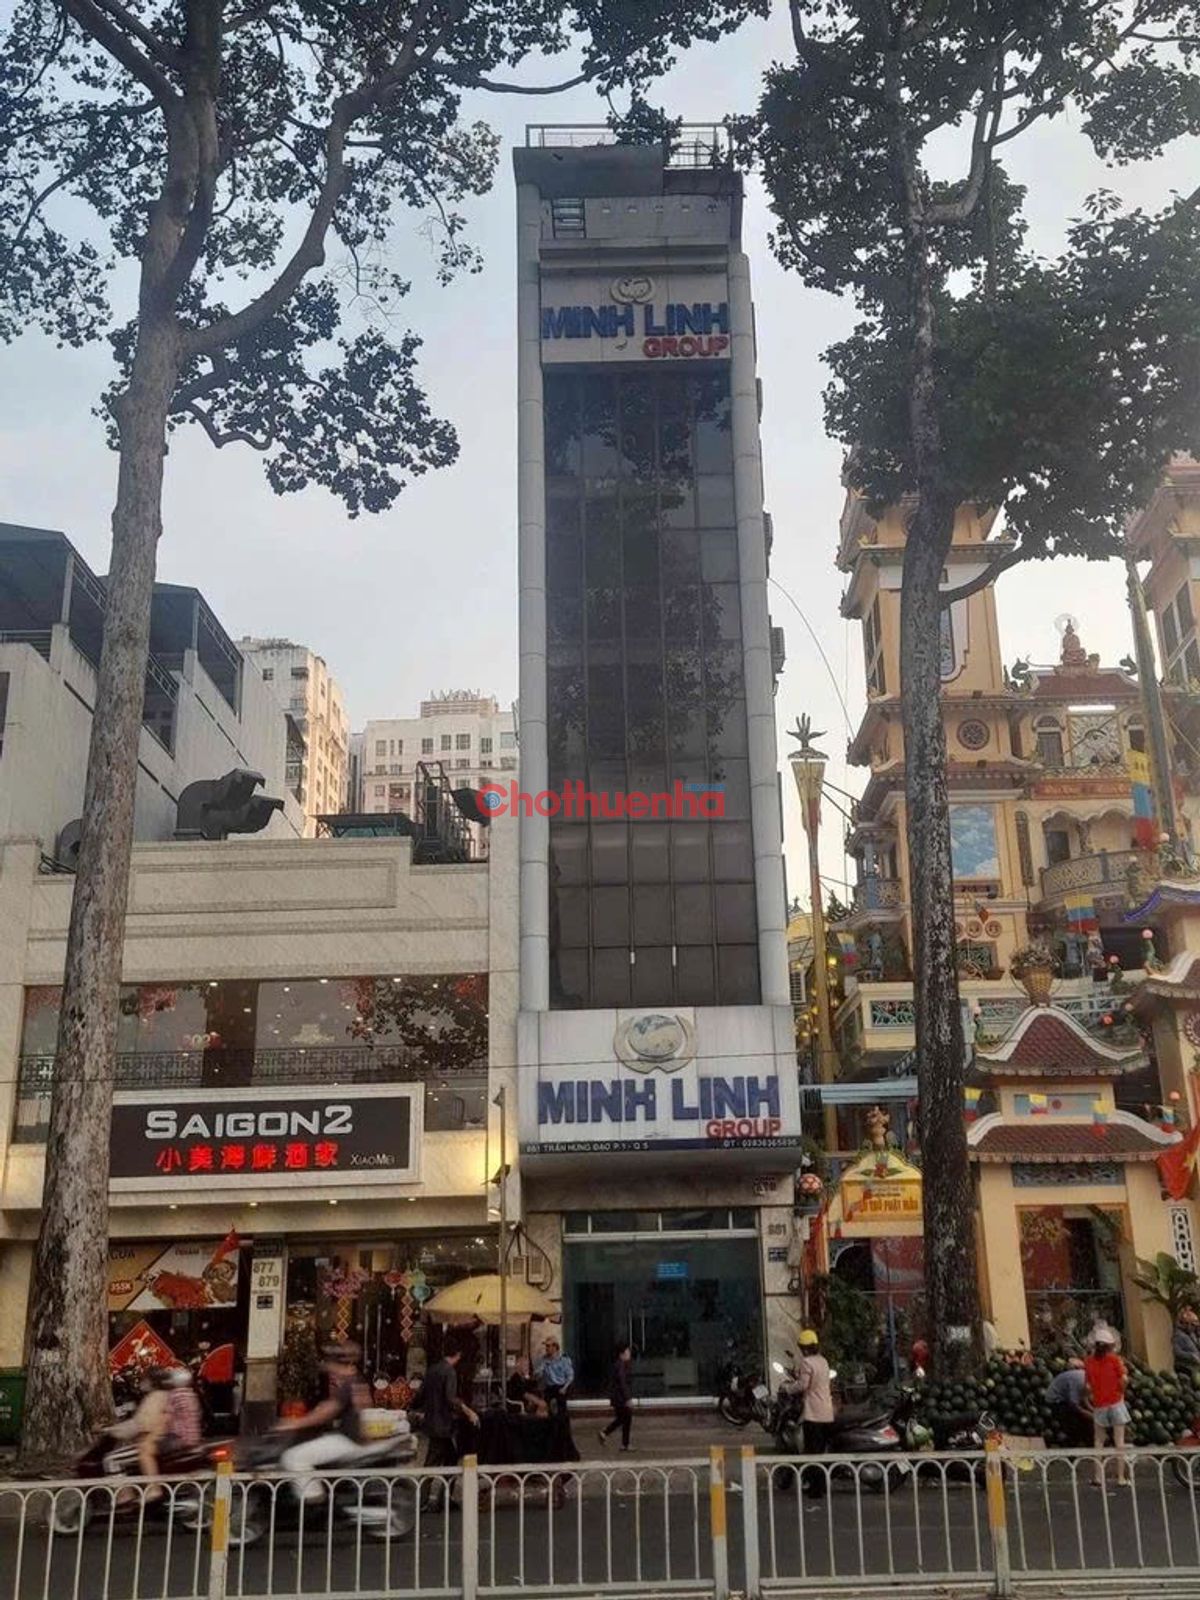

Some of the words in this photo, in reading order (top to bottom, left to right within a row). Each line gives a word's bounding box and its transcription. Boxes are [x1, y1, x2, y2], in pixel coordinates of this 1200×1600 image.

[541, 304, 635, 339] MINH
[644, 303, 729, 336] LINH
[643, 336, 729, 358] GROUP
[538, 1079, 657, 1125] MINH
[671, 1075, 781, 1121] LINH
[145, 1104, 353, 1139] SAIGON2
[706, 1119, 782, 1139] GROUP
[253, 1261, 275, 1274] 877
[259, 1275, 280, 1288] 879
